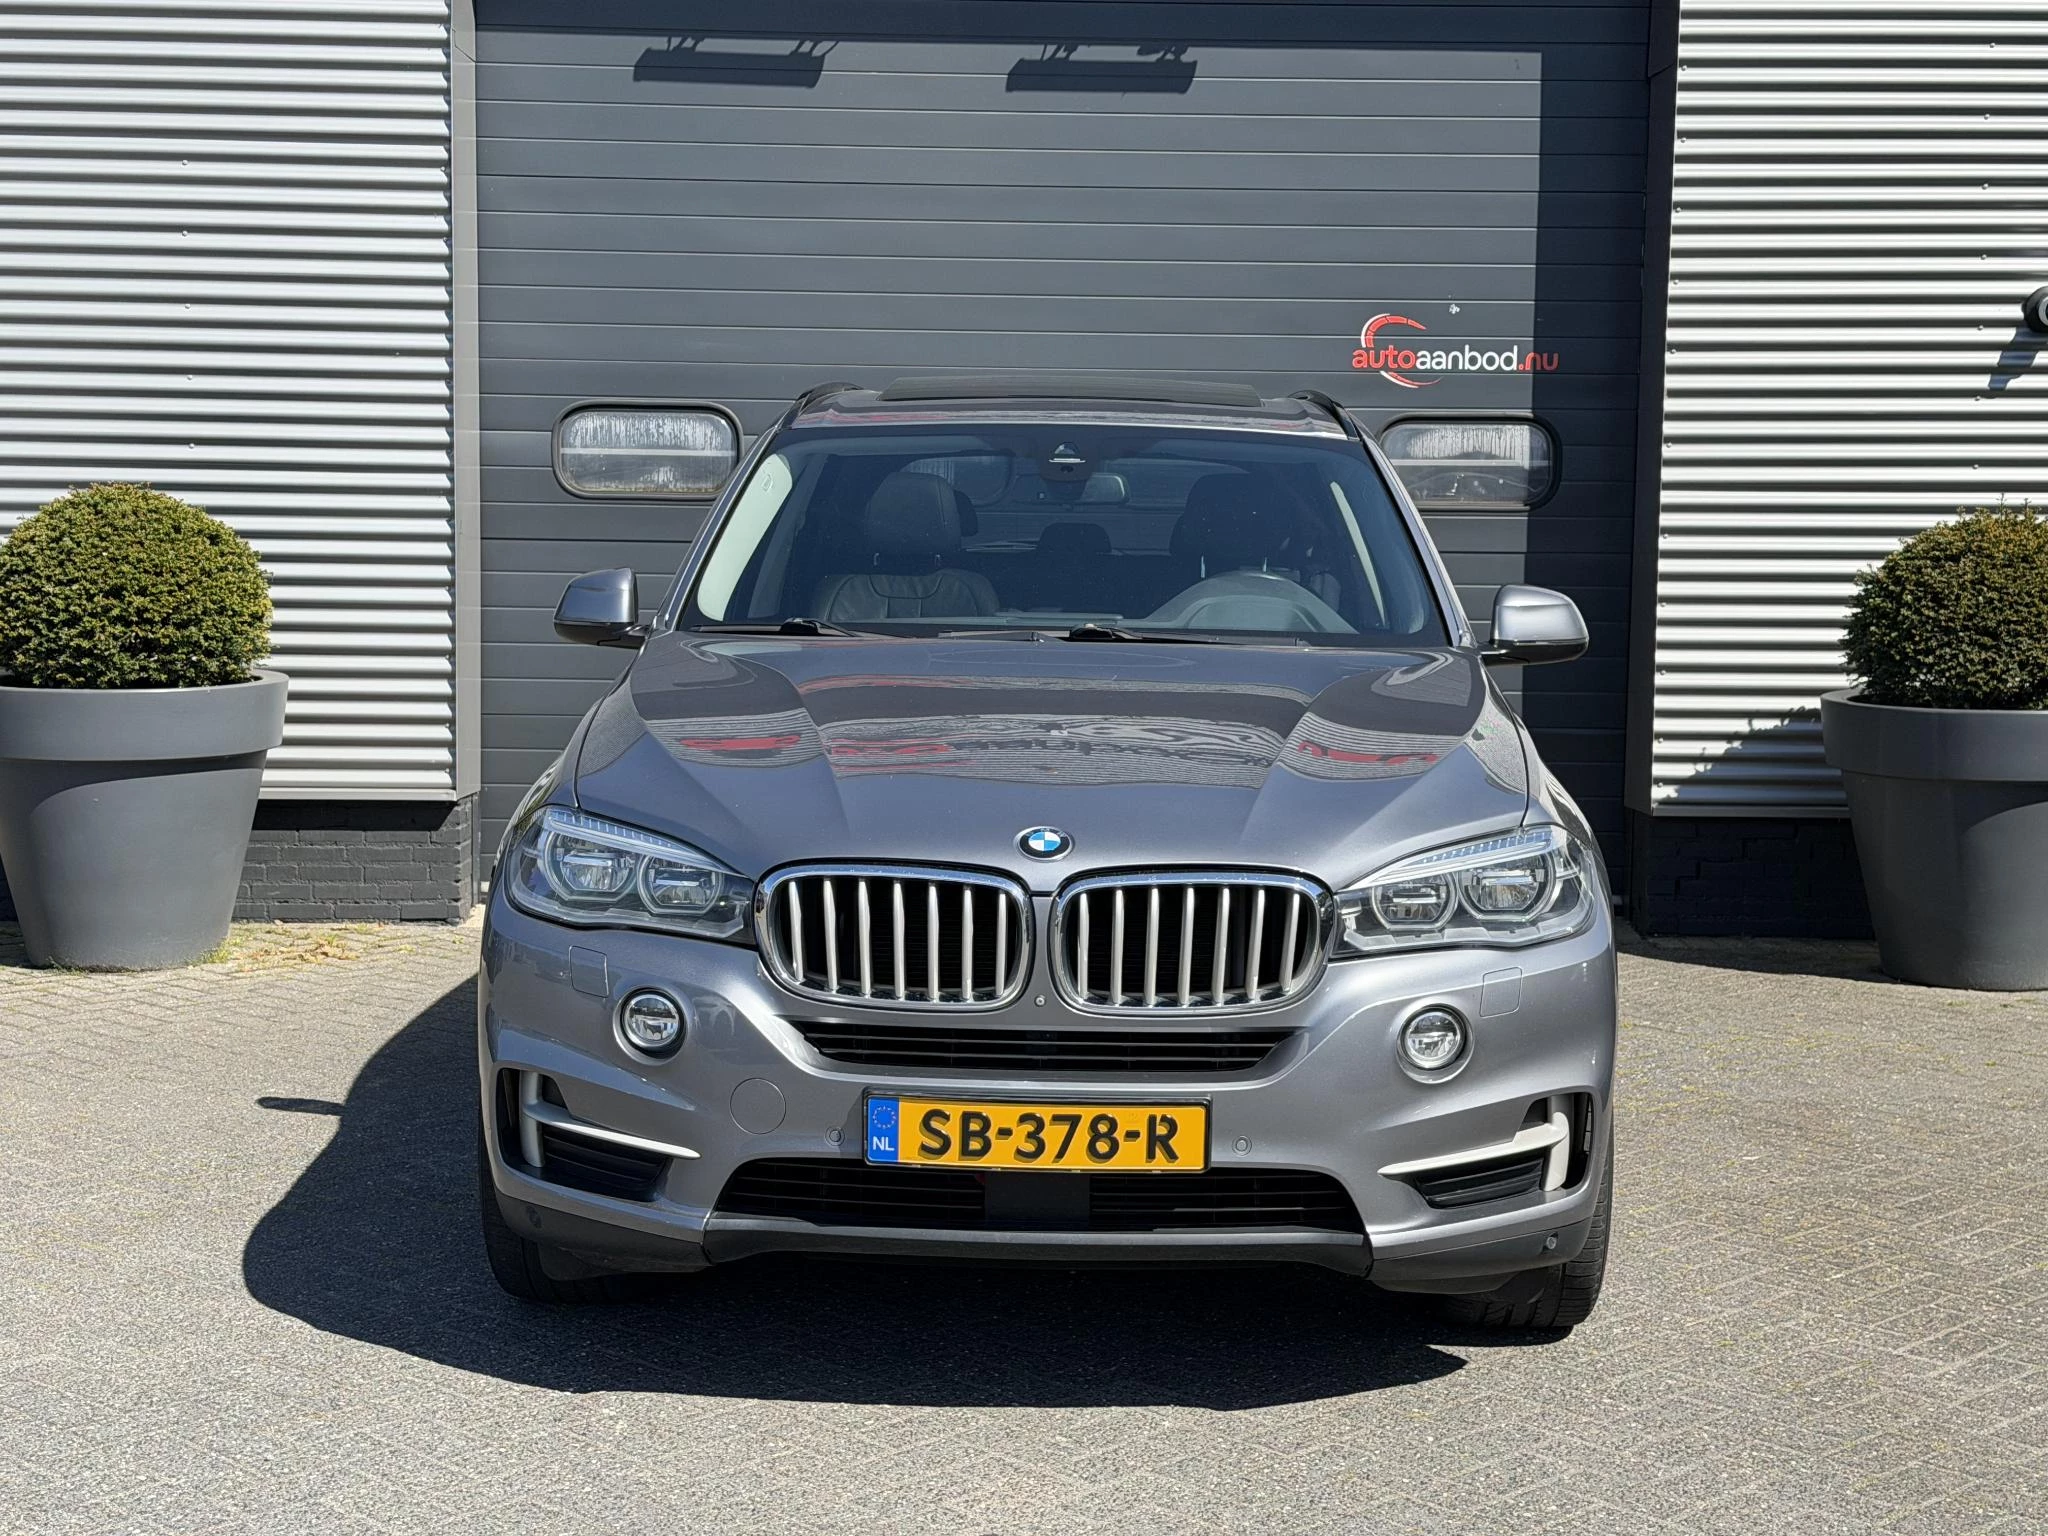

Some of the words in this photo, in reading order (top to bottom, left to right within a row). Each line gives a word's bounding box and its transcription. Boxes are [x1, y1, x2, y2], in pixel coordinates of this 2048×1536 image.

[1352, 345, 1559, 371] autoaanbod.nu
[872, 1136, 895, 1152] NL
[918, 1109, 1179, 1163] SB-378-R
